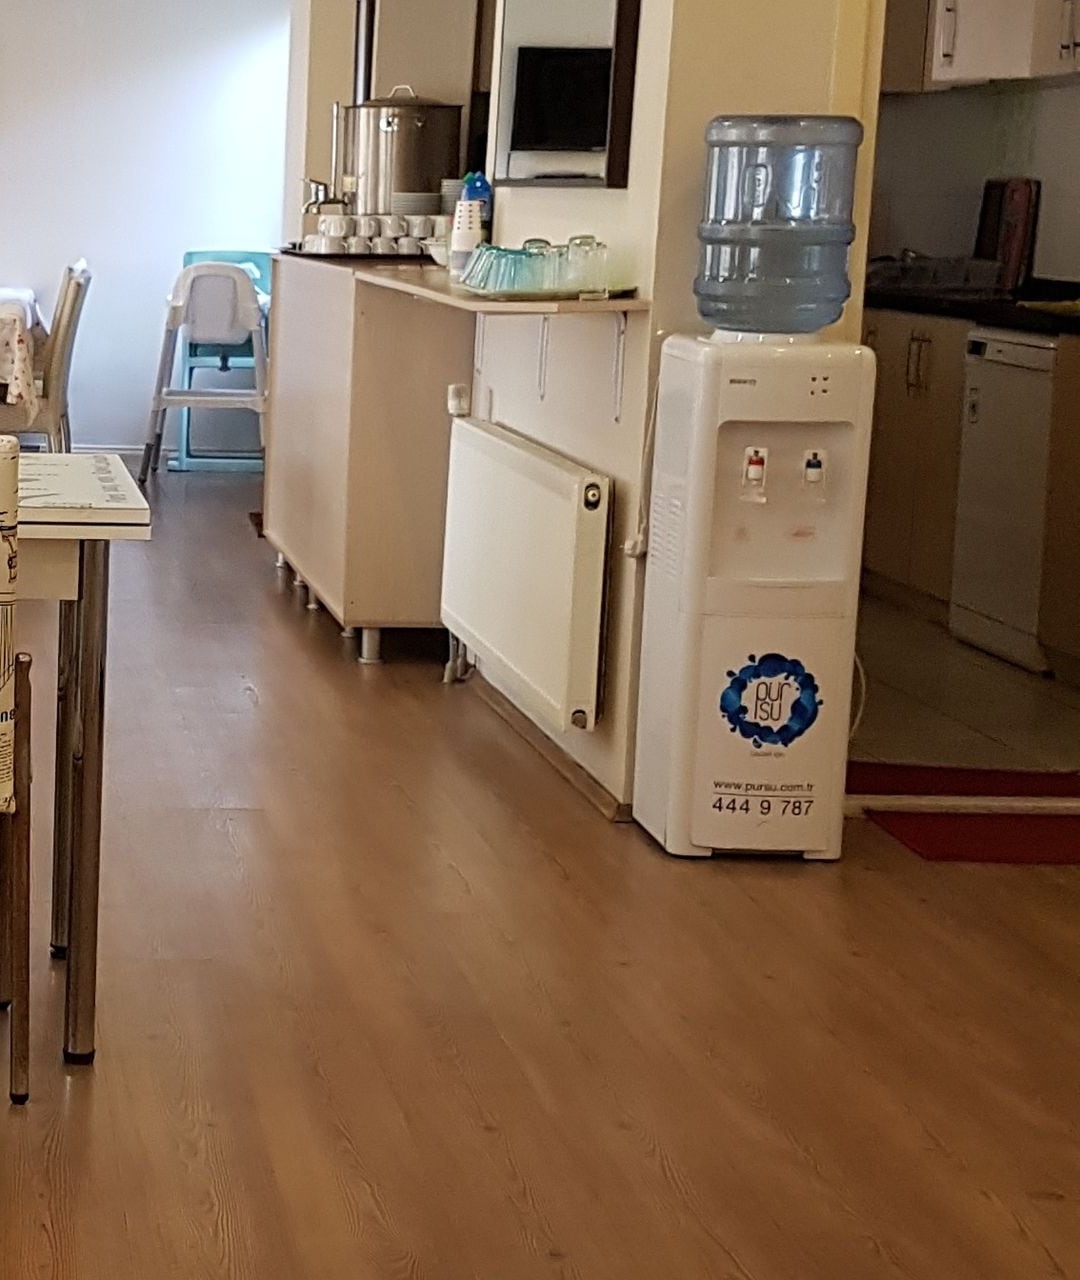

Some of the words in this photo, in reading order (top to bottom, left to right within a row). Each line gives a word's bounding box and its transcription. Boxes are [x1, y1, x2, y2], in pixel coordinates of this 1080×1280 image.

[713, 797, 751, 813] 444
[760, 800, 771, 816] 9
[781, 800, 814, 816] 787
